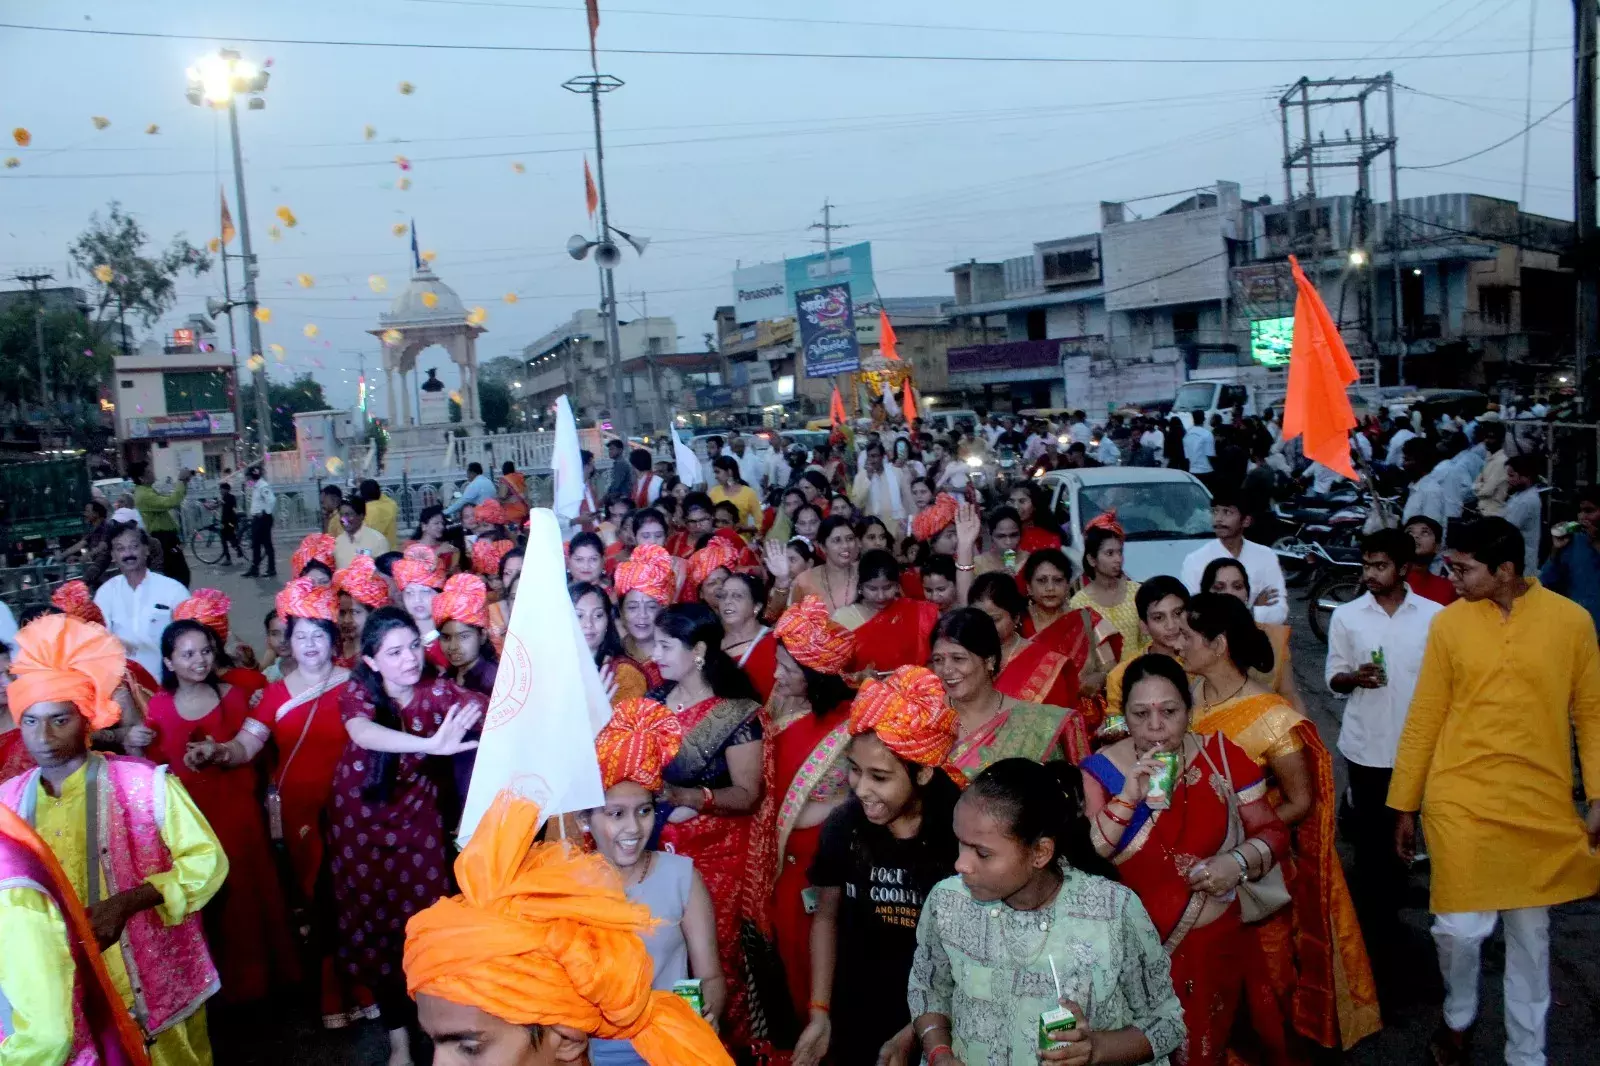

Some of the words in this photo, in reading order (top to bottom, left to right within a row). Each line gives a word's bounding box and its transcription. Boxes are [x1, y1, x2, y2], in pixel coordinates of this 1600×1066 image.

[738, 284, 784, 301] Panasonic
[870, 866, 908, 885] FOCU
[875, 905, 893, 914] AND
[895, 906, 918, 917] FORG
[882, 915, 898, 924] THE
[900, 917, 917, 928] RES
